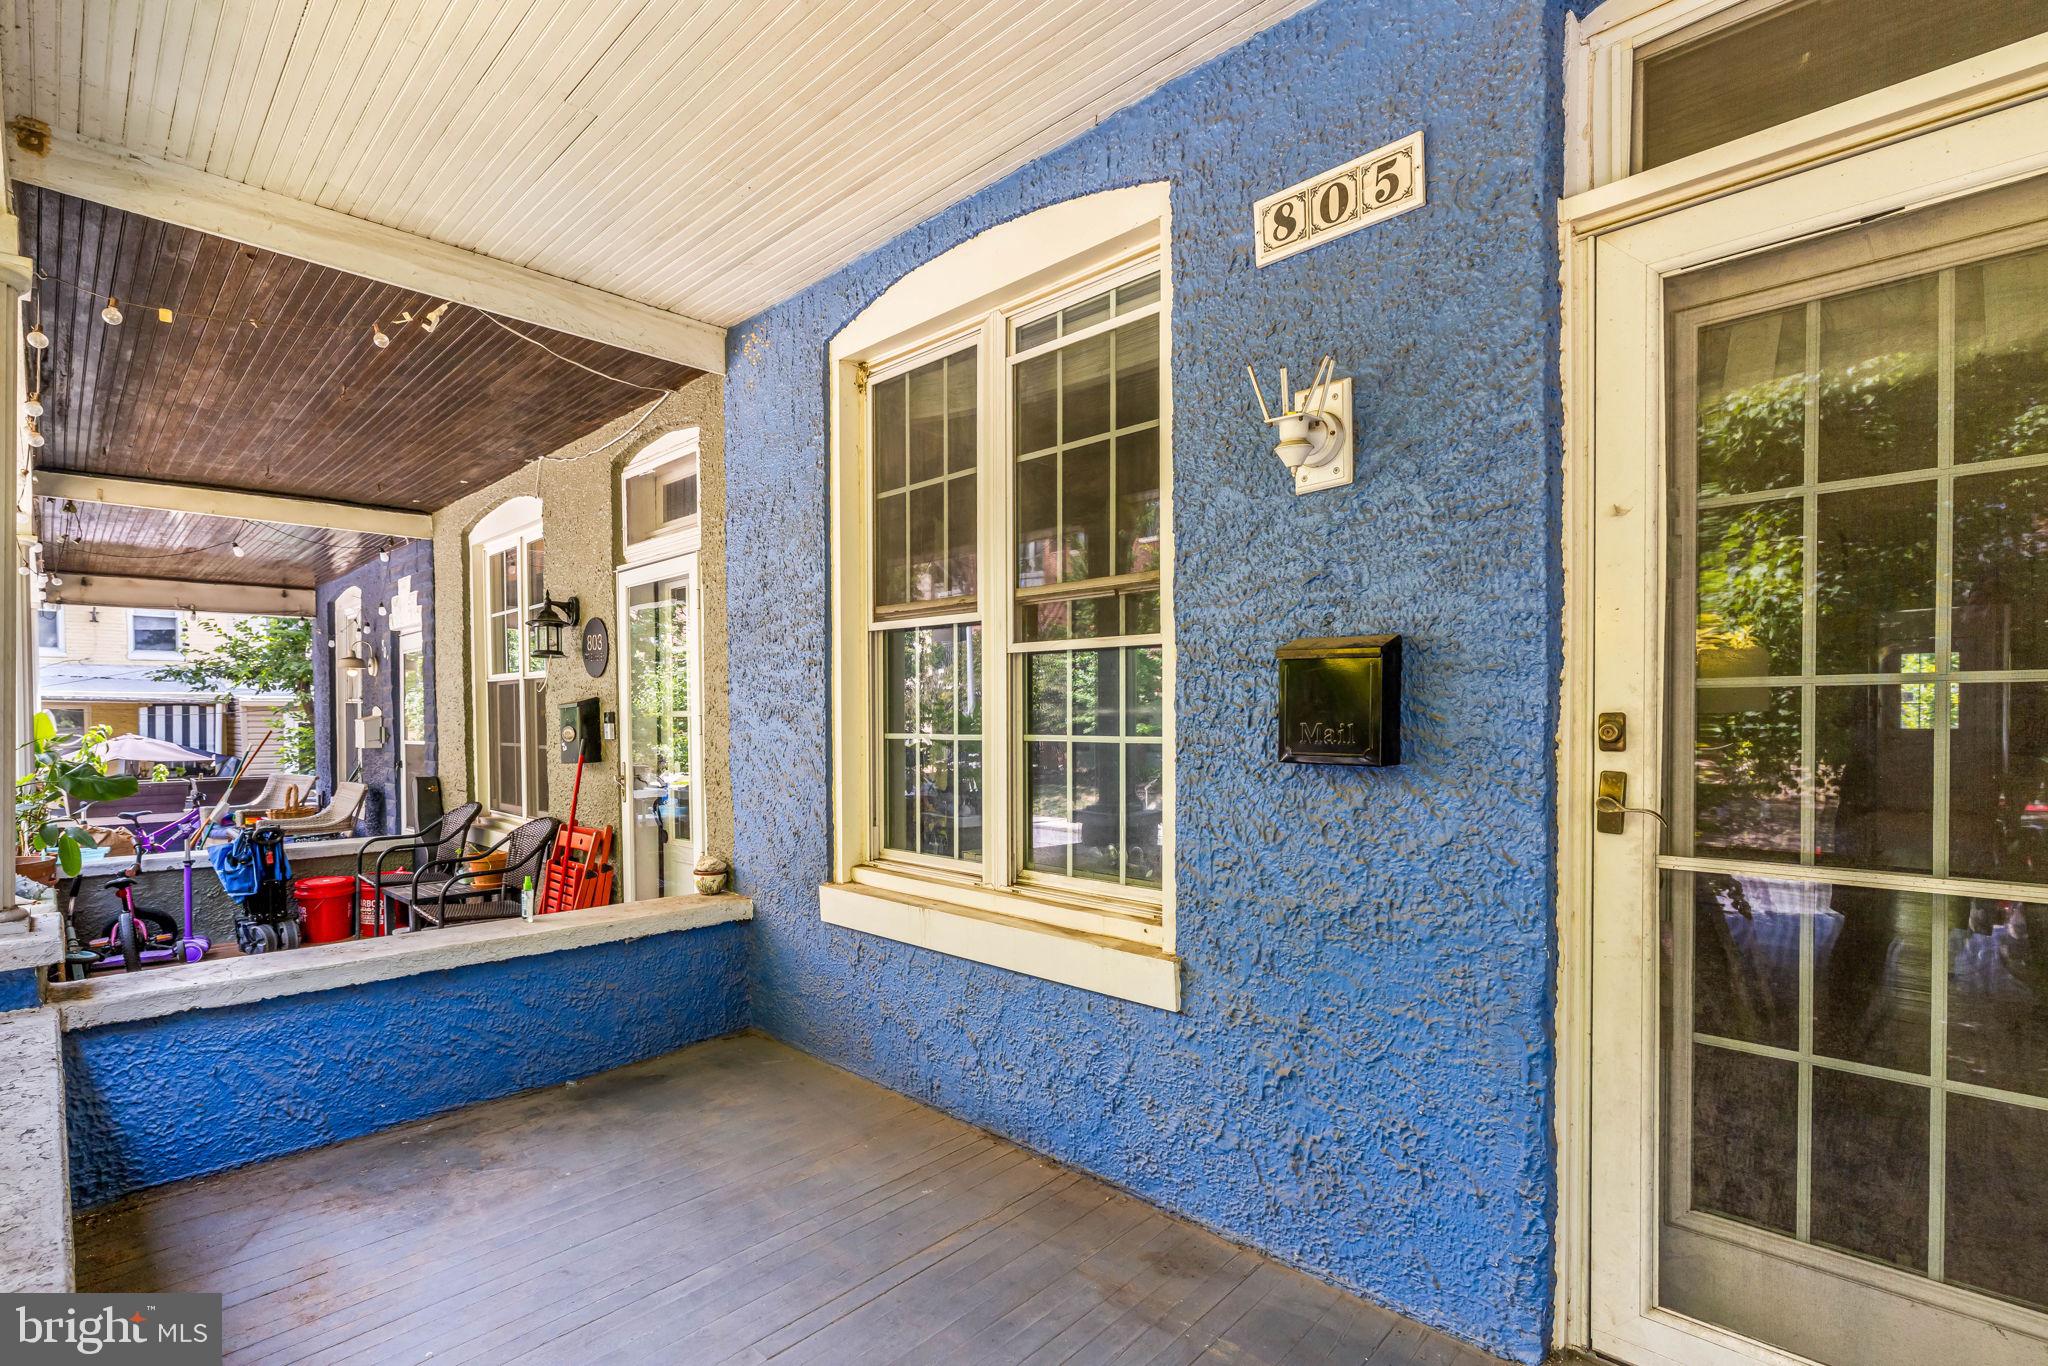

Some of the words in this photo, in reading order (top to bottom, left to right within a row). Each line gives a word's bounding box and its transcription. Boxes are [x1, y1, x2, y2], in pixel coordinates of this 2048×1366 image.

[1273, 157, 1400, 242] 805
[586, 633, 603, 651] 803
[1299, 722, 1356, 745] Mail
